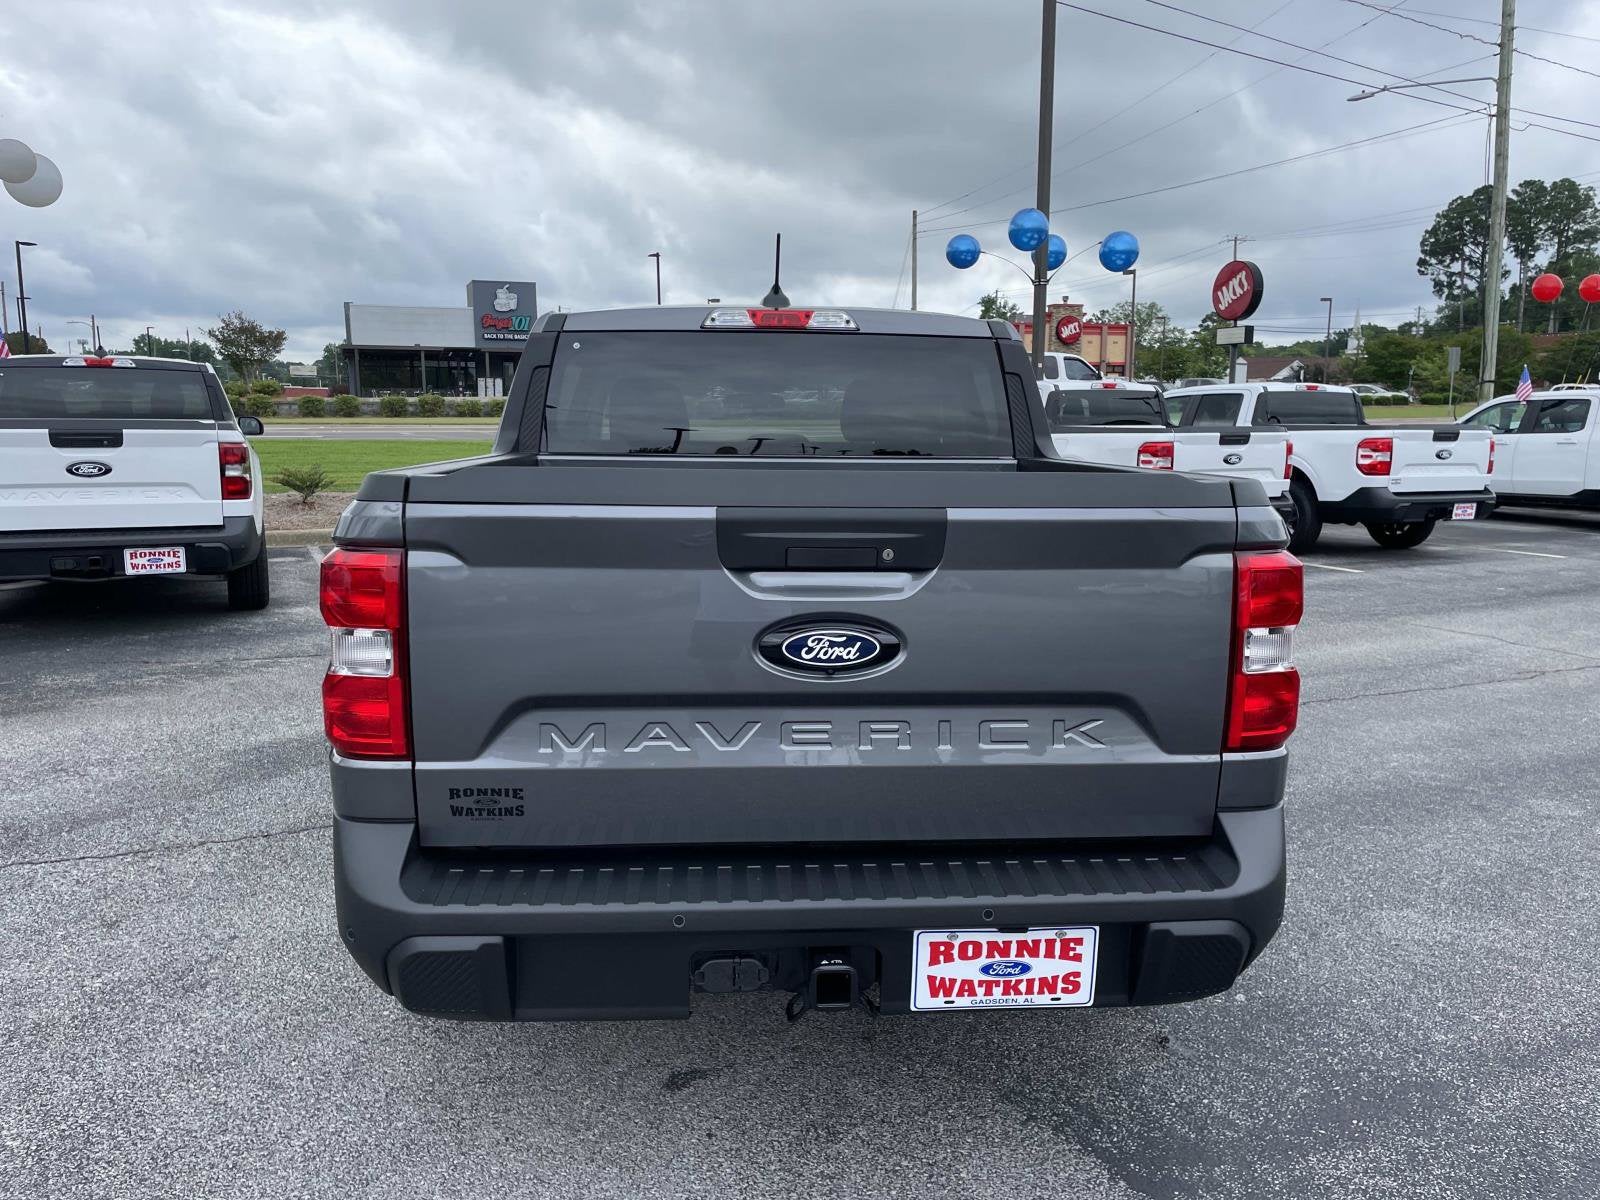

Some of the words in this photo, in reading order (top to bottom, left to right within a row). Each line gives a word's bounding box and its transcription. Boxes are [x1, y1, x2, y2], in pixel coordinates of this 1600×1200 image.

[510, 316, 530, 331] 101
[78, 464, 99, 475] Ford
[129, 550, 181, 560] RONNIE
[130, 560, 181, 570] WATKINS
[801, 635, 860, 660] Ford
[538, 719, 1107, 754] MAVERICK
[448, 787, 525, 801] RONNIE
[449, 804, 525, 817] WATKINS
[928, 937, 1084, 967] RONNIE
[988, 962, 1022, 975] Ford
[926, 971, 1082, 999] WATKINS
[970, 998, 1021, 1006] GADSDEN,
[1022, 997, 1036, 1005] AL
